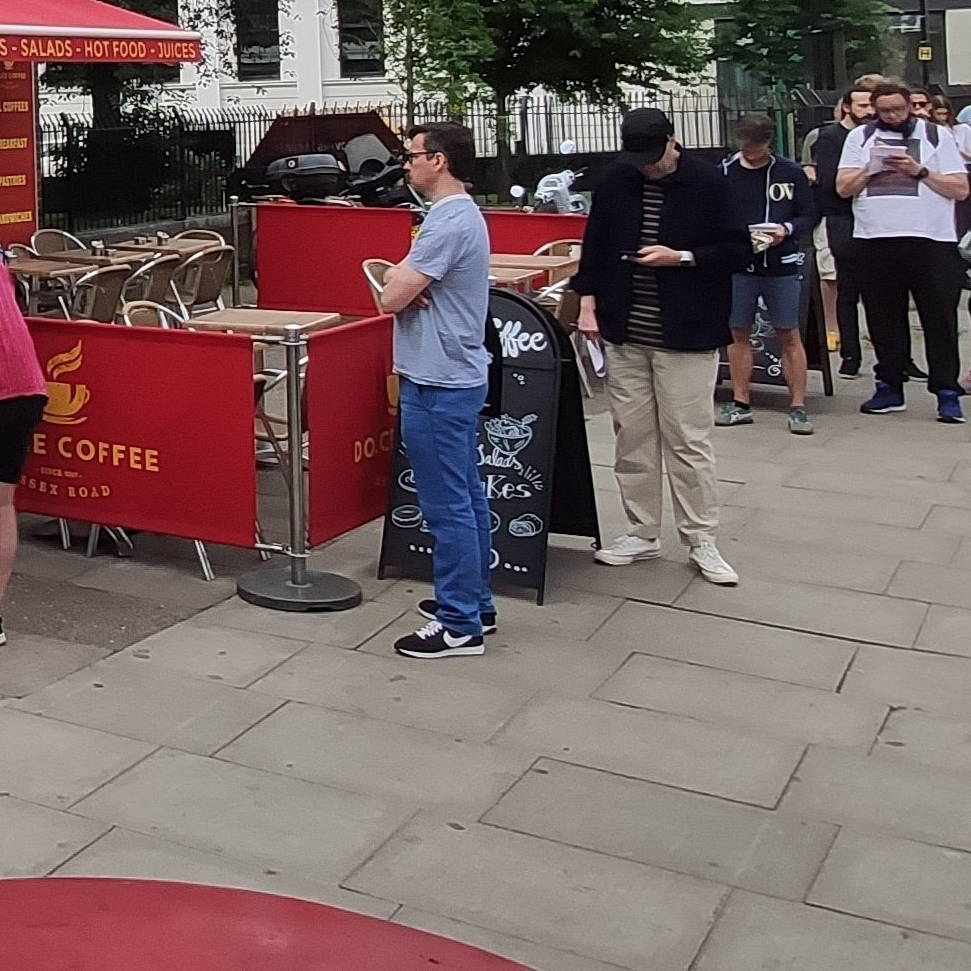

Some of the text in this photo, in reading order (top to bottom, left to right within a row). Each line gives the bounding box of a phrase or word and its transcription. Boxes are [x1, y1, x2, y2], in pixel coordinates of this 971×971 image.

[20, 38, 73, 58] SALADS
[85, 40, 111, 58] HOT
[113, 40, 147, 59] FOOD
[158, 42, 196, 59] JUICES
[492, 318, 548, 357] ffee
[58, 436, 160, 472] COFFEE
[20, 475, 110, 498] SSEX ROAD
